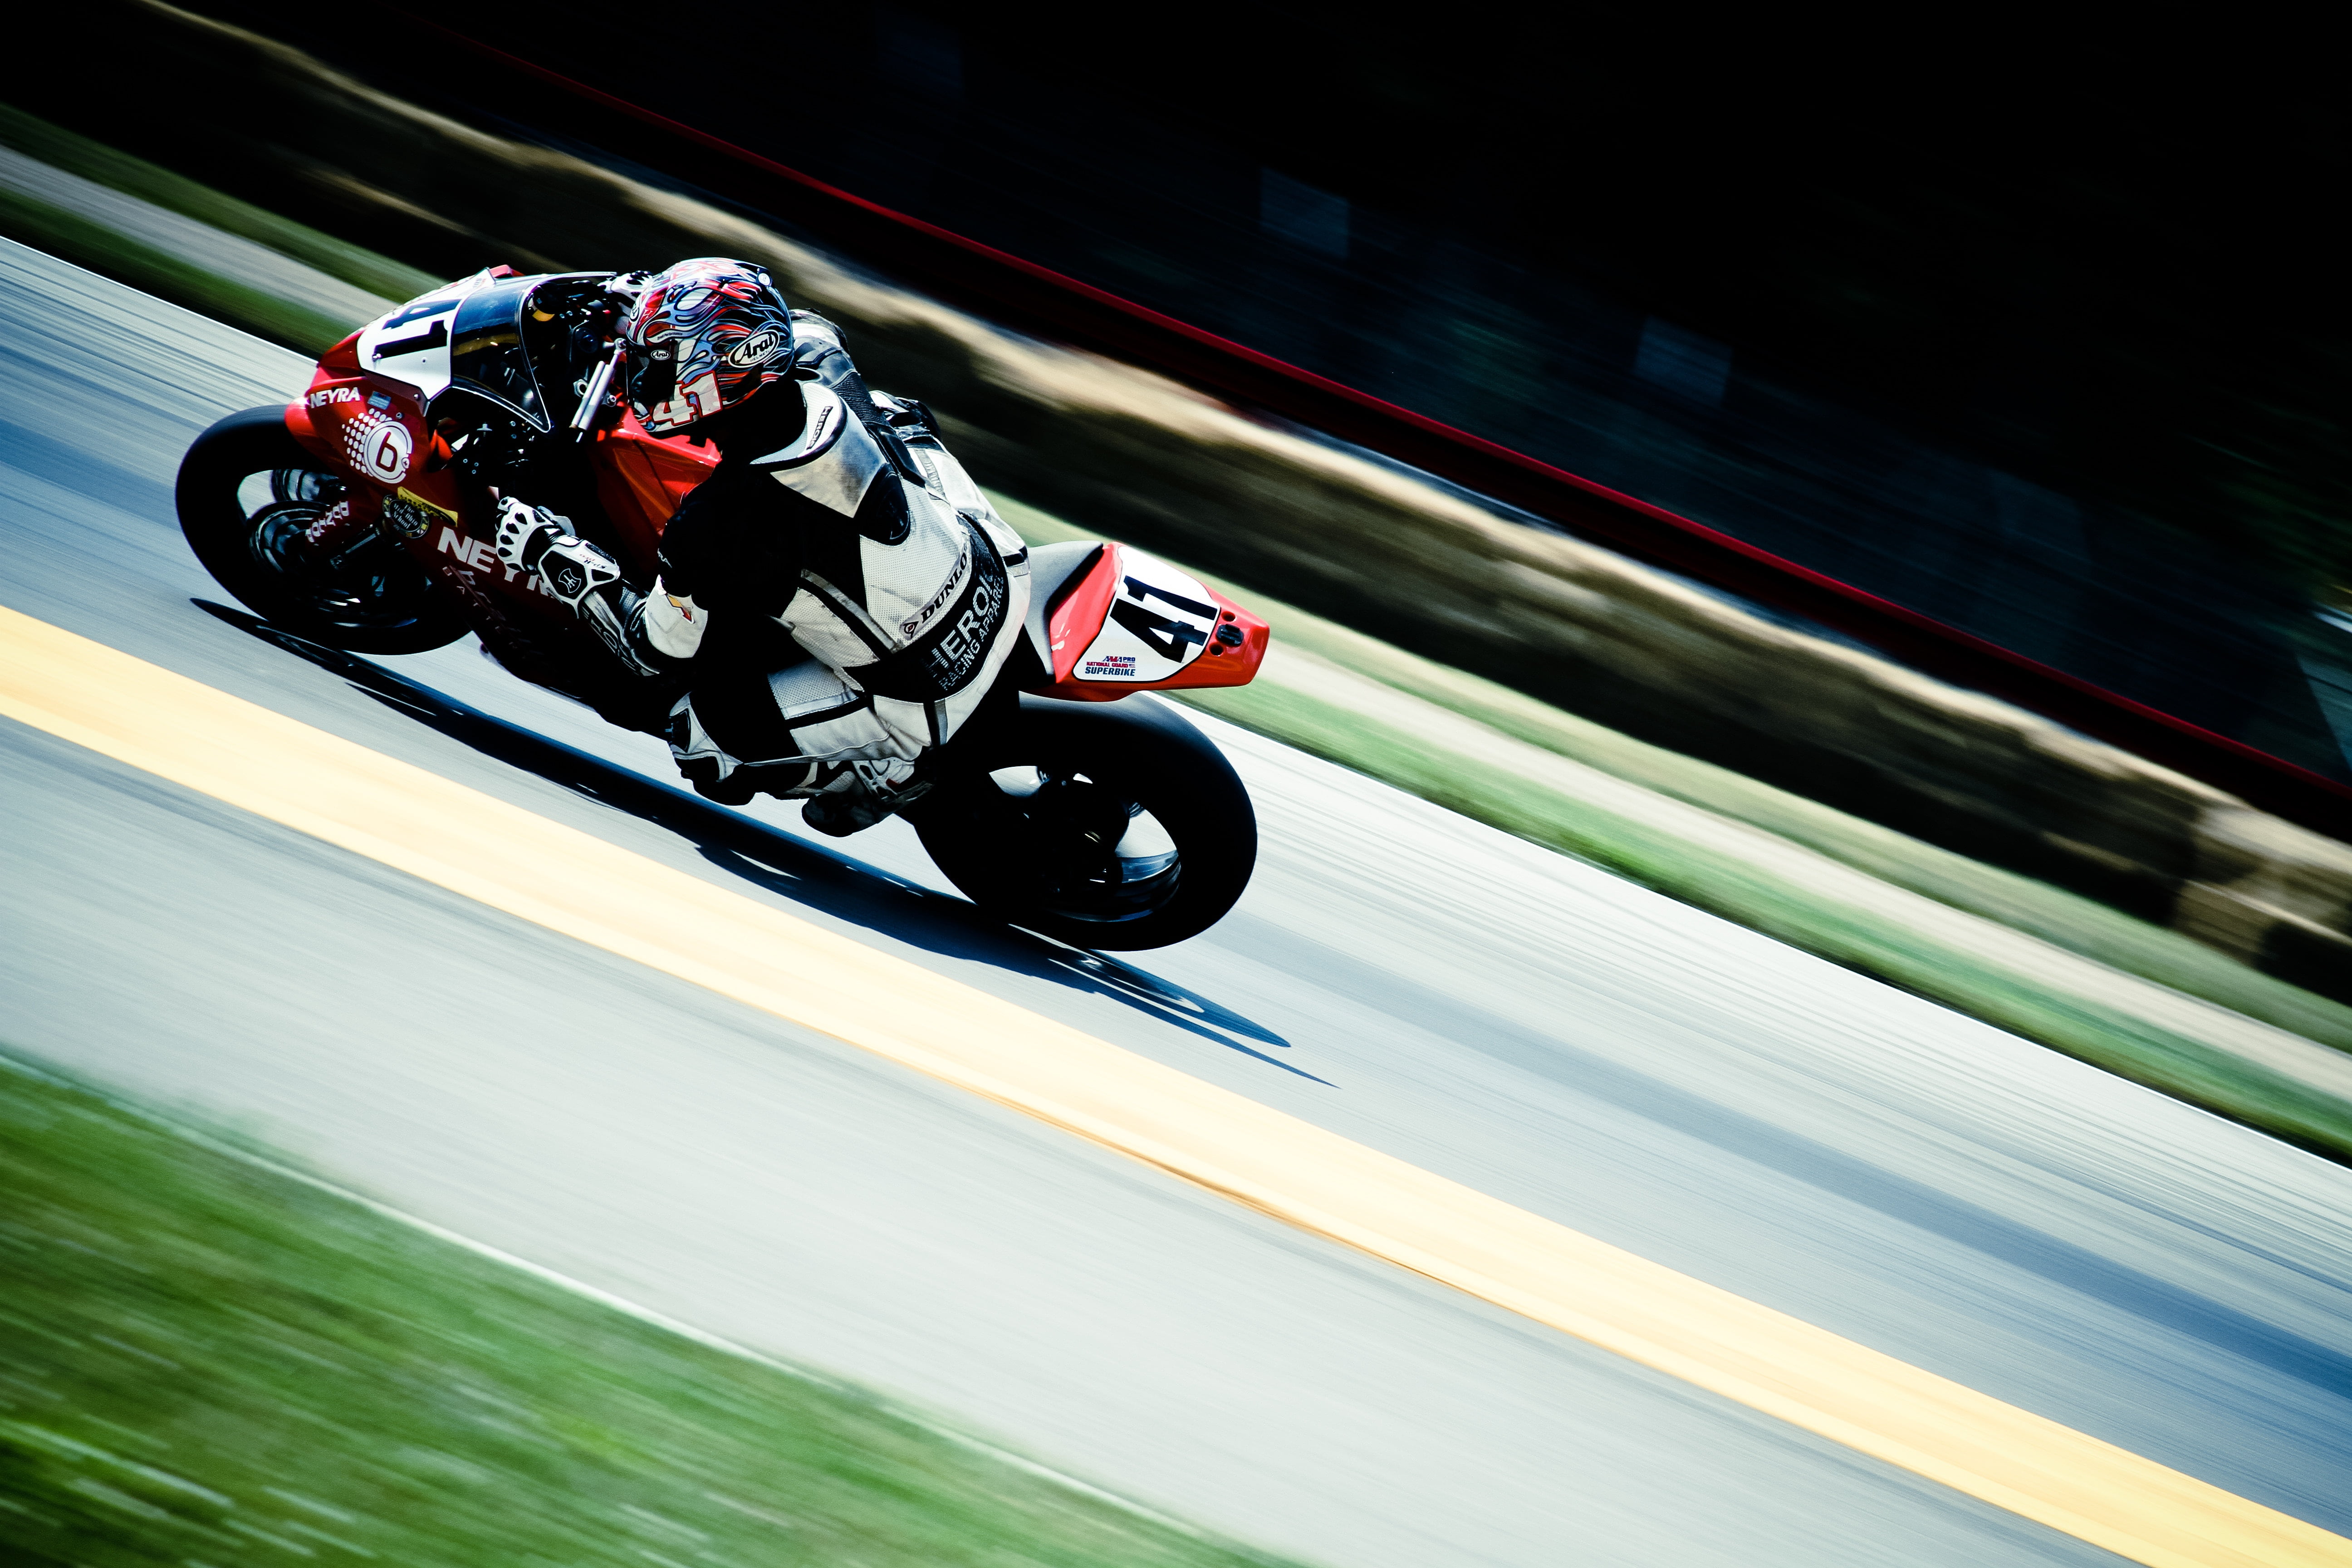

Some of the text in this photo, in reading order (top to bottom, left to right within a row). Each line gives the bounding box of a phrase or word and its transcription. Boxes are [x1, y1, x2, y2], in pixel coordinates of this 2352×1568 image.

[373, 299, 461, 359] 41
[735, 333, 774, 364] Arai
[310, 387, 360, 408] NEYRA
[652, 370, 722, 426] 41
[305, 501, 349, 543] DUNLOP
[921, 545, 967, 624] DUNLO
[1110, 575, 1218, 663] 41
[938, 639, 980, 691] RACING
[1085, 666, 1136, 676] SUPERBIKE
